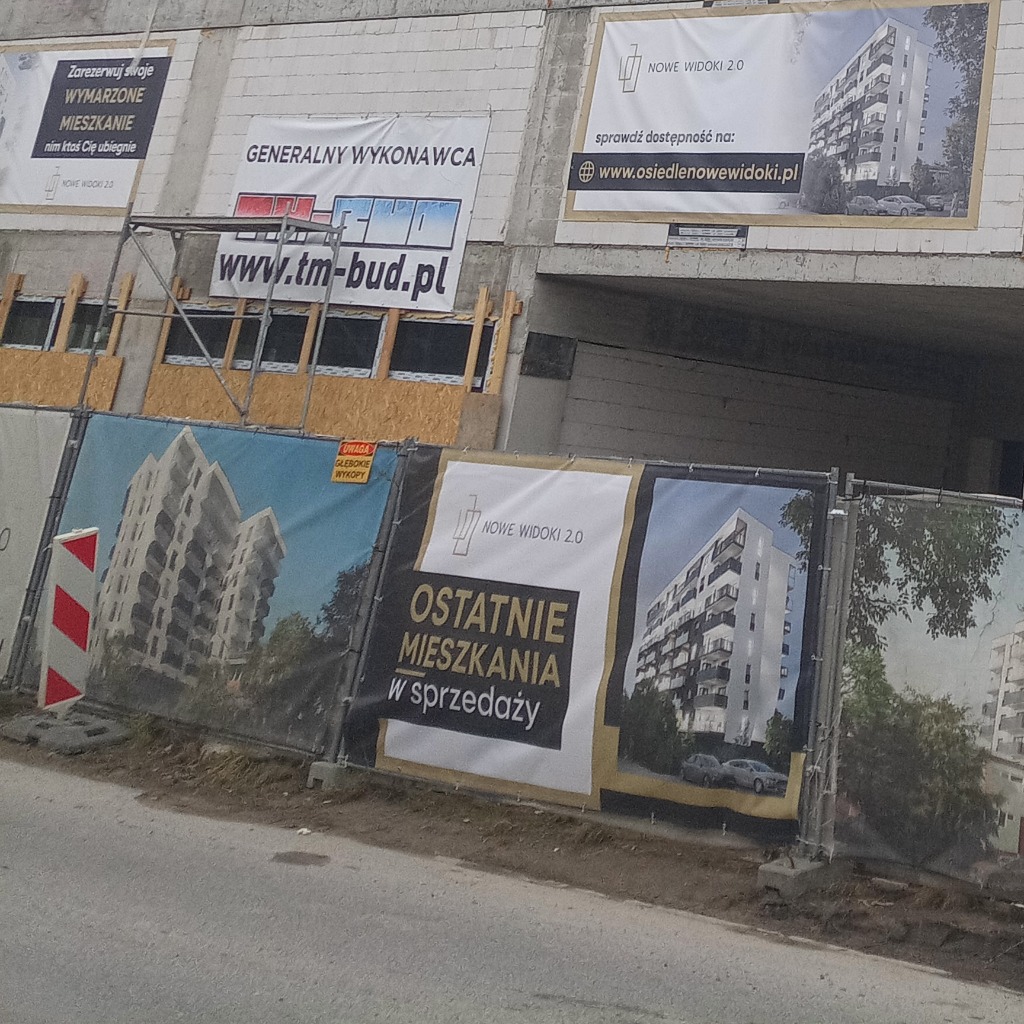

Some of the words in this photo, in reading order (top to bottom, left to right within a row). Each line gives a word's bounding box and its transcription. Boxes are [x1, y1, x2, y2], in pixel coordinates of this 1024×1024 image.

[67, 63, 125, 80] Zarezerwuj
[647, 61, 680, 73] NOWE
[684, 60, 723, 72] WIDOKI
[727, 59, 744, 71] 2.0
[64, 87, 147, 104] WYMARZONE
[58, 114, 136, 131] MIESZKANIE
[595, 130, 644, 146] sprawdź
[645, 129, 713, 146] dostępność
[715, 131, 735, 143] na:
[44, 140, 60, 152] nim
[61, 140, 81, 152] ktoś
[81, 140, 97, 156] Cię
[98, 140, 137, 156] ubiegnie
[246, 144, 348, 164] GENERALNY
[352, 145, 476, 167] WYKONAWCA
[599, 163, 799, 184] www.osiedlenowewidoki.pl
[219, 250, 449, 302] www.tm-bud.pl
[342, 444, 370, 455] UWAGA
[335, 470, 366, 479] WYKOPY
[482, 520, 516, 536] NOWE
[519, 524, 561, 542] WIDOKI
[564, 529, 584, 544] 2.0
[409, 583, 569, 644] OSTATNIE
[397, 631, 561, 688] MIESZKANIA
[410, 681, 541, 731] sprzedaży
